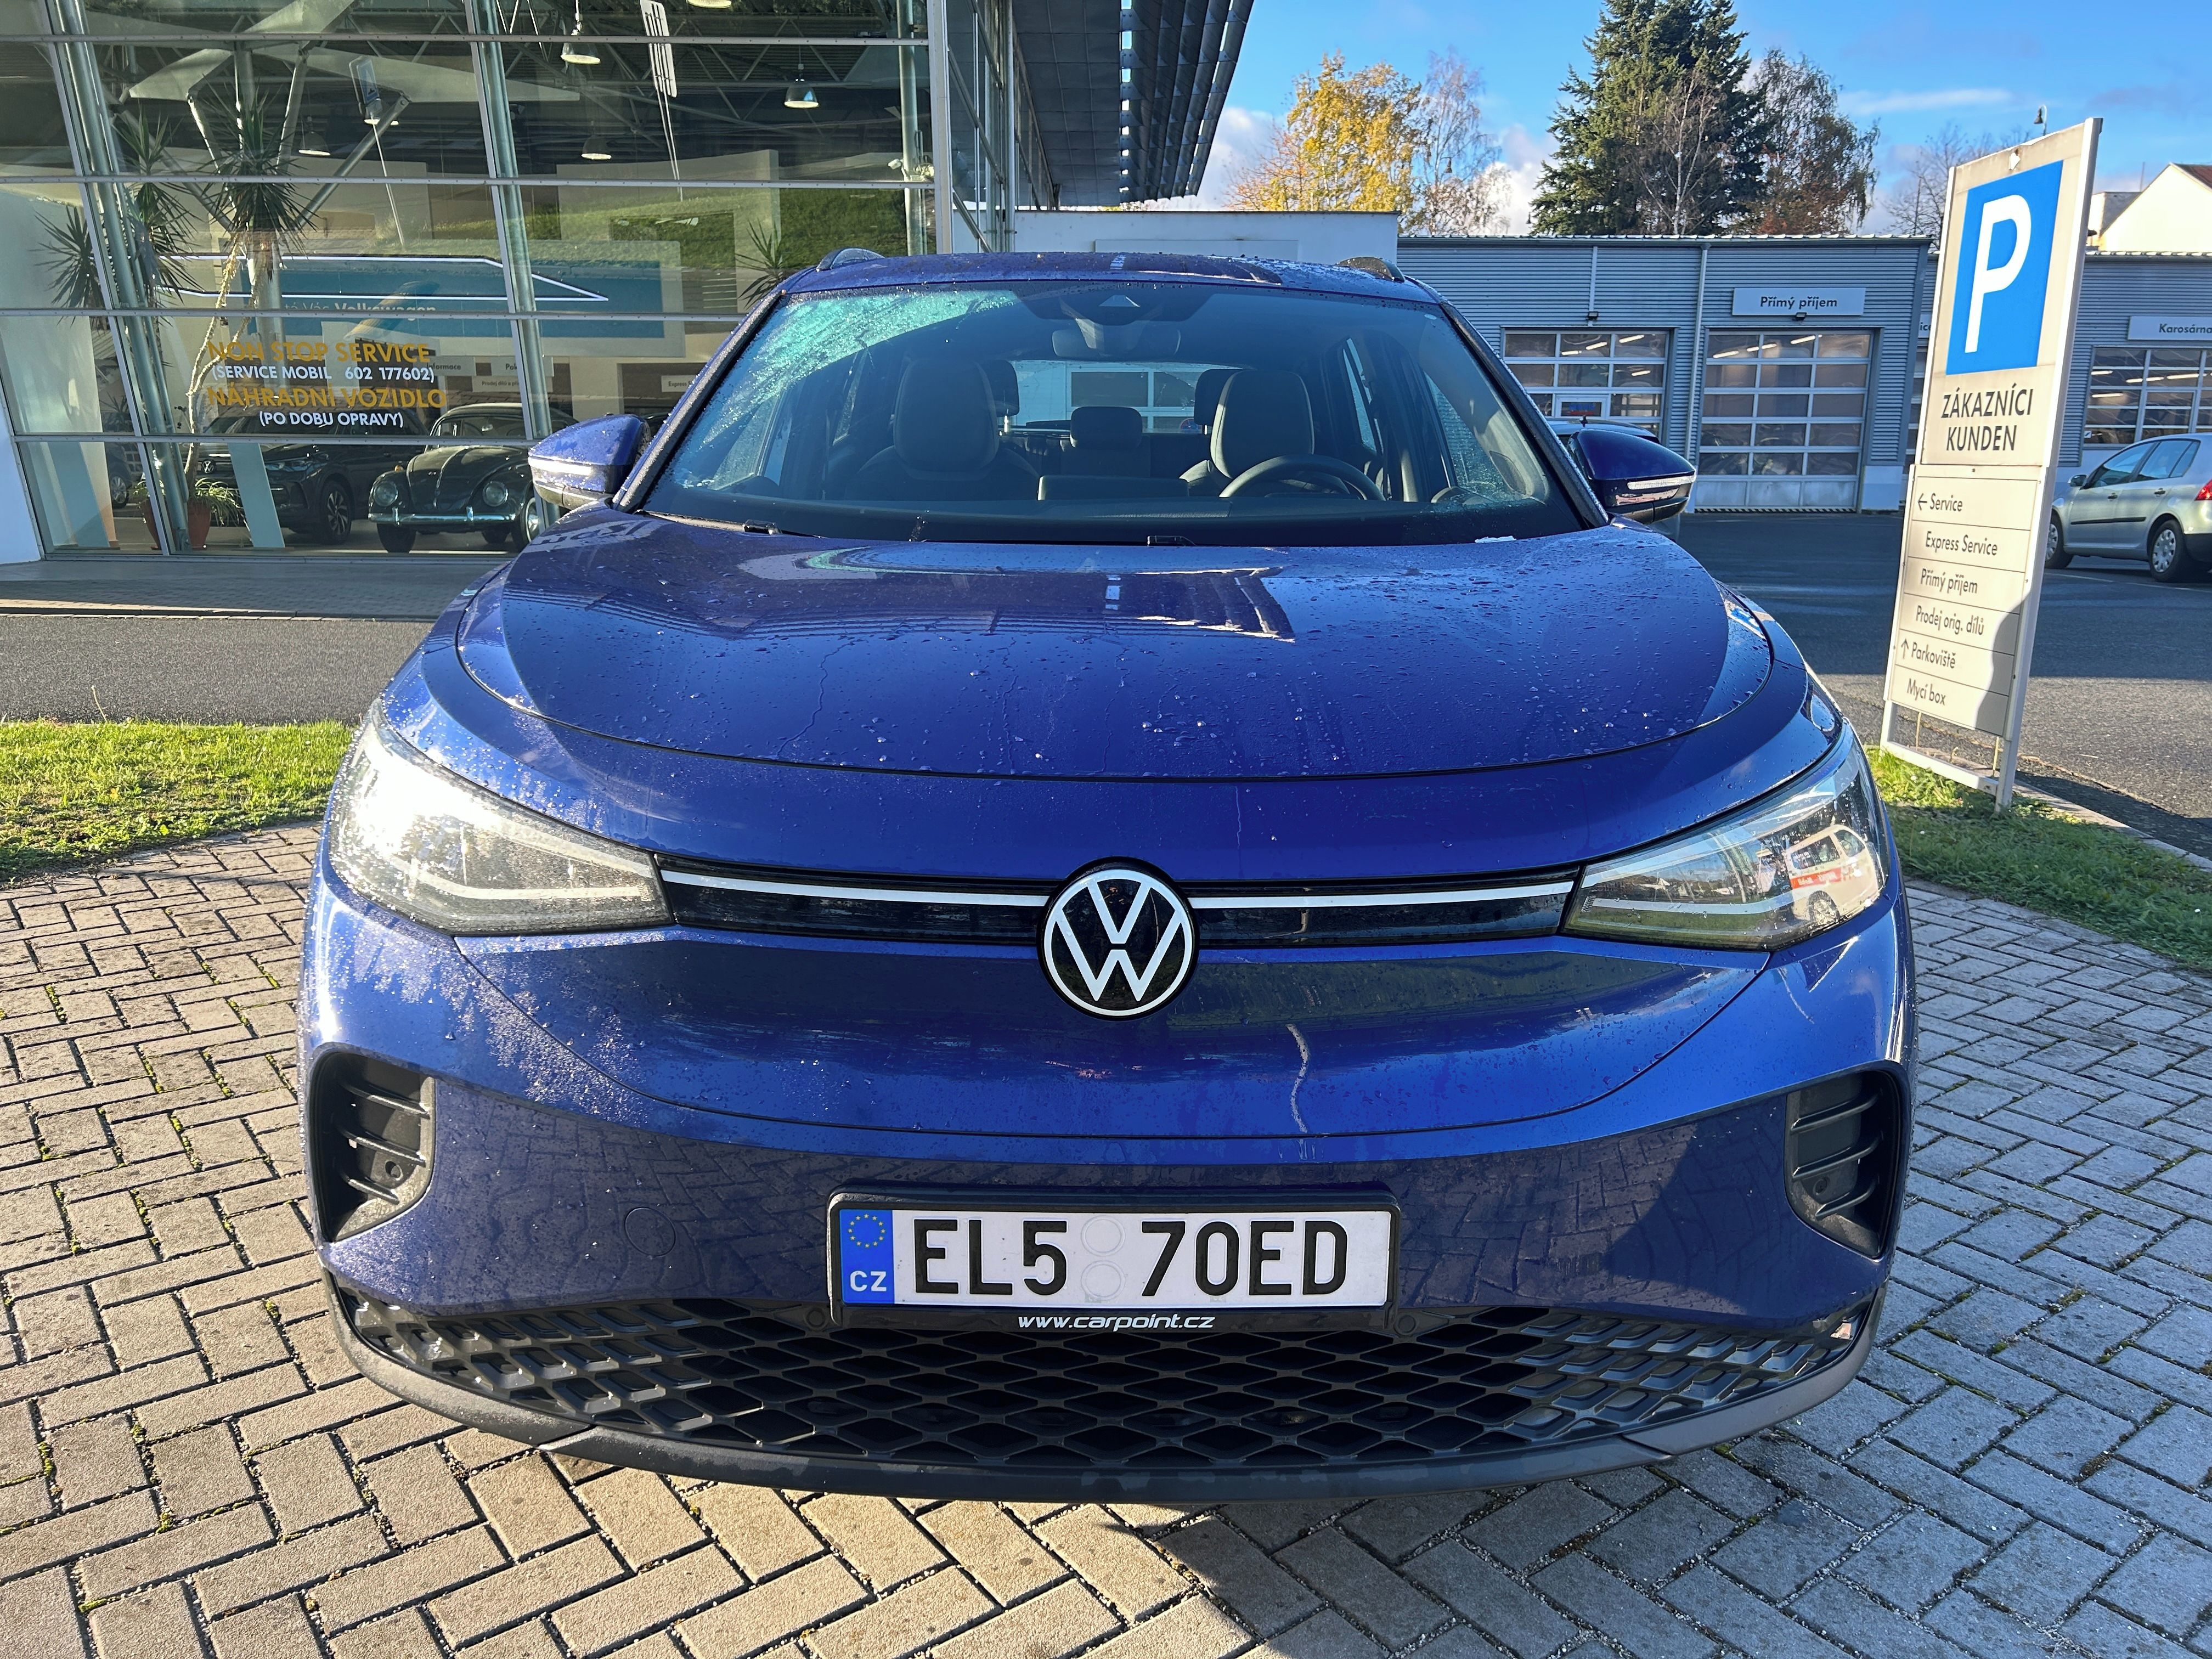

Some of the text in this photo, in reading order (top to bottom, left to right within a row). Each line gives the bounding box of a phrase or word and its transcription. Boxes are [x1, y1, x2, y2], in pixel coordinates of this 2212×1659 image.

[1965, 195, 2031, 353] P
[1760, 296, 1838, 309] Přímý příjem
[208, 341, 431, 363] NON STOP SERVICE
[212, 364, 435, 383] (SERVICE MOBIL 602 177602)
[207, 381, 447, 408] NÁHRADNÍ VOZIDLO
[1941, 382, 2033, 418] ZÁKAZNÍCI
[259, 411, 403, 428] (PO DOBU OPRAVY)
[1946, 425, 2017, 451] KUNDEN
[1929, 493, 1963, 512] Service
[1925, 531, 1997, 556] Express Service
[1921, 568, 1978, 596] Přímý příjem
[1916, 605, 1984, 635] Prodej orig. dílů
[1911, 642, 1956, 669] Parkoviště
[1906, 678, 1946, 706] Mycí box
[913, 1219, 1347, 1296] EL5 70ED
[849, 1271, 887, 1292] CZ
[1018, 1314, 1215, 1332] www.carpoint.cz
